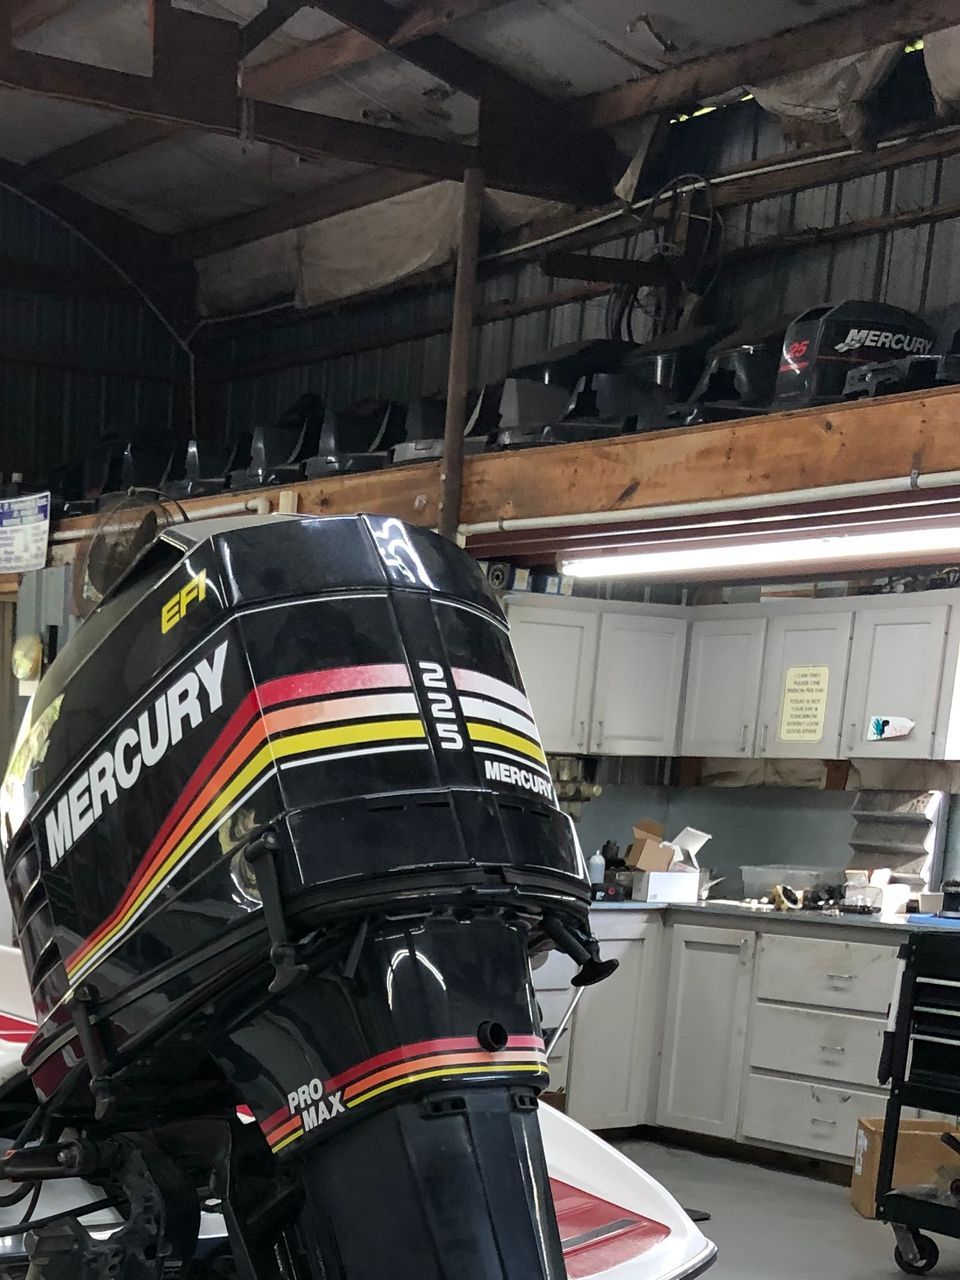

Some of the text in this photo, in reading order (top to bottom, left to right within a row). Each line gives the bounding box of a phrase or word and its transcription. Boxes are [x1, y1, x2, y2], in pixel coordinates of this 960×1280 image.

[836, 329, 932, 355] MERCURY
[160, 568, 207, 634] EFI
[418, 661, 464, 750] 225
[44, 640, 229, 868] MERCURY
[484, 760, 553, 800] MERCURY
[287, 1078, 323, 1115] PRO
[302, 1091, 346, 1132] MAX
